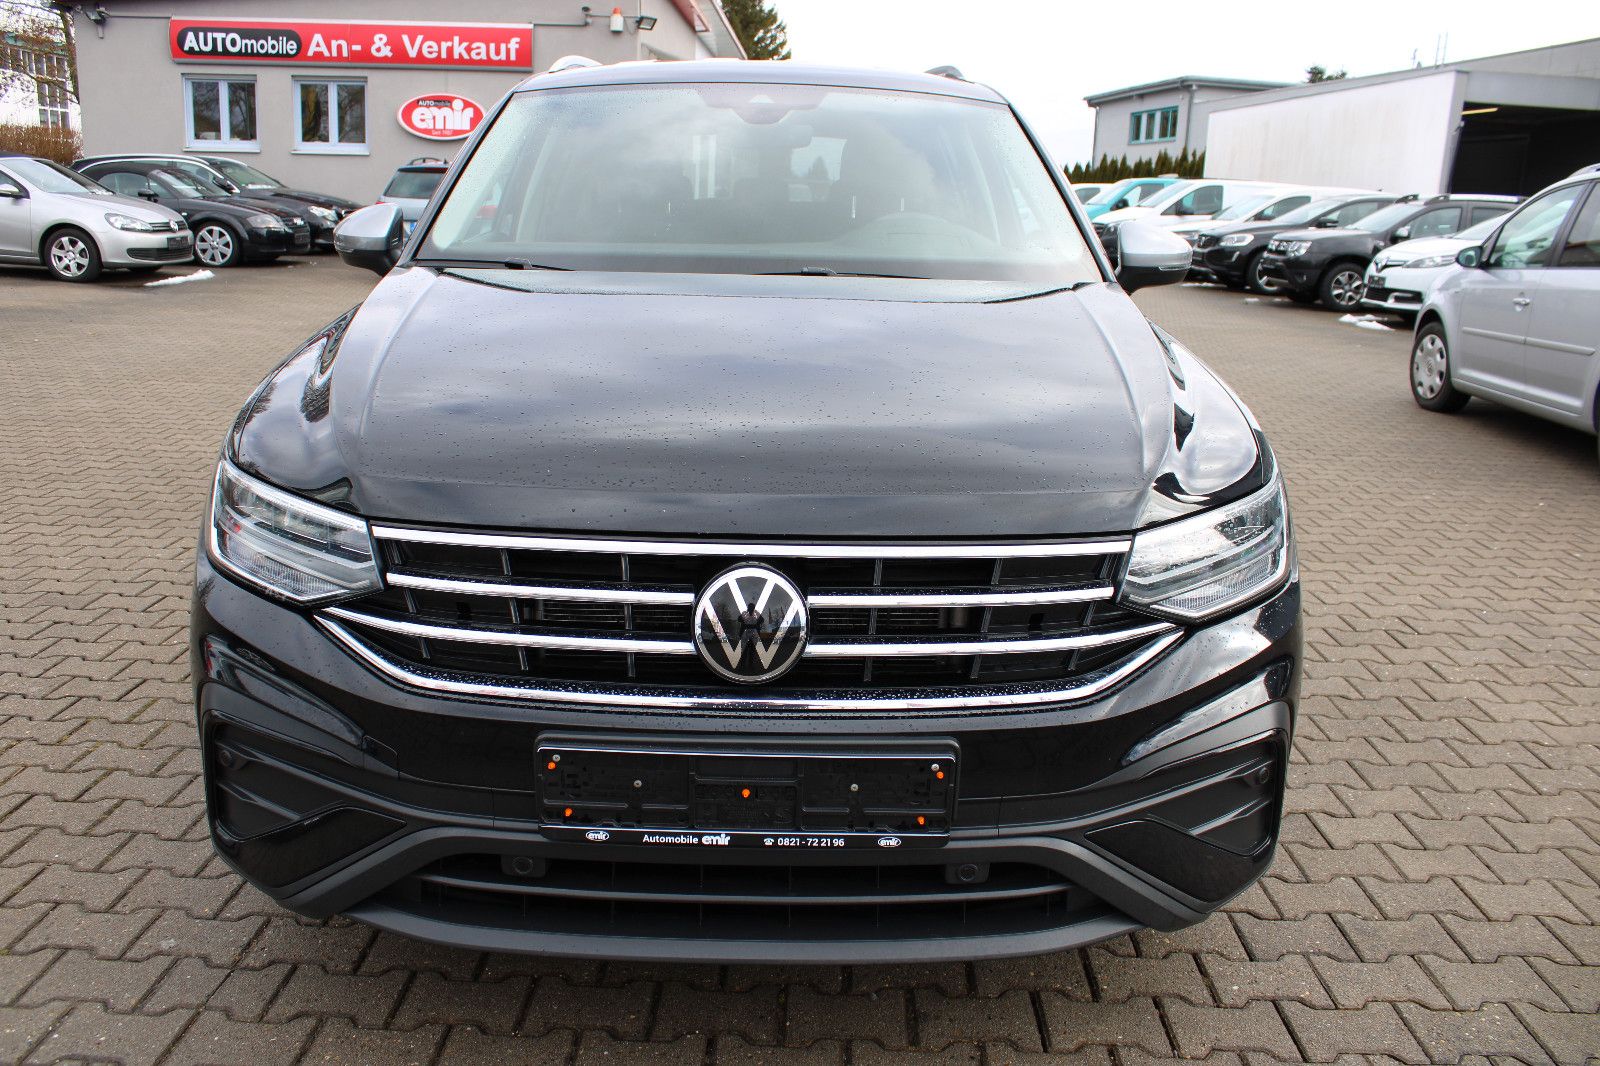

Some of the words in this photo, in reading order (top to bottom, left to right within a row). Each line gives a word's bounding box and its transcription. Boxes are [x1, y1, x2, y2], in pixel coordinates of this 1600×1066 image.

[183, 31, 298, 55] AUTOmobile
[306, 33, 362, 58] An-
[370, 33, 393, 58] &
[401, 34, 521, 61] Verkauf
[411, 99, 474, 130] emir
[643, 834, 699, 844] Automobile
[701, 833, 731, 846] emir
